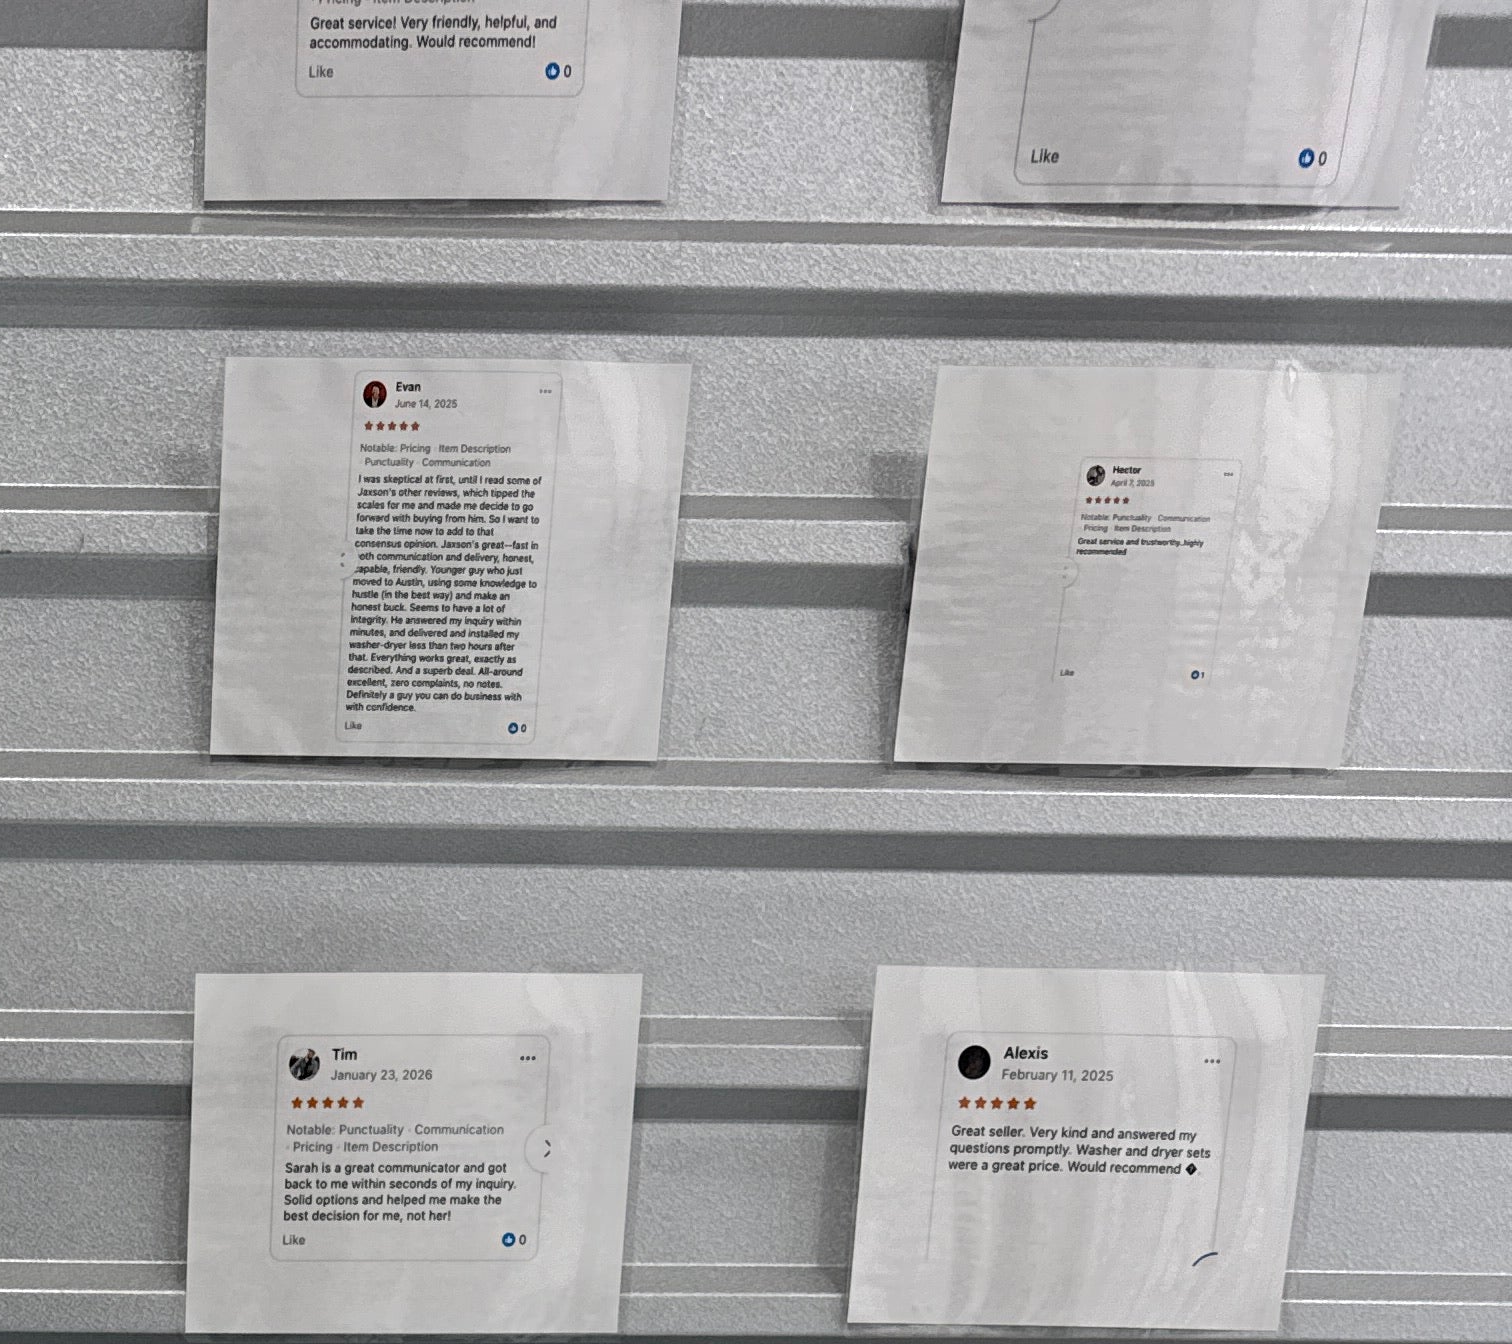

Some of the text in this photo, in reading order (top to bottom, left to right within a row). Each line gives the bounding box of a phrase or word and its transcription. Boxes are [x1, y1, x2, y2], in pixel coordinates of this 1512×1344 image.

[310, 15, 557, 31] Great service! Very friendly, helpful, and
[310, 35, 536, 50] accommodating. Would recommend!
[309, 65, 334, 78] Like
[564, 65, 572, 78] 0
[1031, 149, 1060, 163] Like
[1318, 151, 1327, 166] 0
[396, 382, 421, 392] Evan
[395, 399, 458, 410] June 14, 2025
[360, 444, 511, 455] Notable: Pricing Item Description
[1112, 466, 1142, 474] Hector
[363, 476, 381, 484] was
[383, 475, 423, 485] skeptical
[424, 476, 434, 484] at
[435, 475, 456, 485] first,
[458, 475, 478, 484] until
[485, 476, 504, 485] read
[533, 476, 542, 485] of
[344, 721, 362, 730] Like
[332, 1048, 357, 1060] Tim
[1004, 1046, 1048, 1059] Alexis
[331, 1069, 433, 1082] January 23, 2026
[1002, 1069, 1113, 1083] February 11, 2025
[286, 1124, 504, 1137] Notable: Punctuality Communication
[952, 1125, 1197, 1143] Great seller. Very kind and answered my
[293, 1141, 439, 1154] Pricing Item Description
[950, 1143, 1211, 1159] questions promptly. Washer and dryer sets
[285, 1162, 507, 1175] Sarah is a great communicator and got
[948, 1161, 1182, 1174] were a great price. Would recommend
[285, 1178, 516, 1191] back to me within seconds of my inquiry.
[284, 1194, 502, 1207] Solid options and helped me make the
[283, 1210, 451, 1223] best decision for me, not her!
[282, 1235, 306, 1245] Like
[519, 1234, 527, 1245] 0
